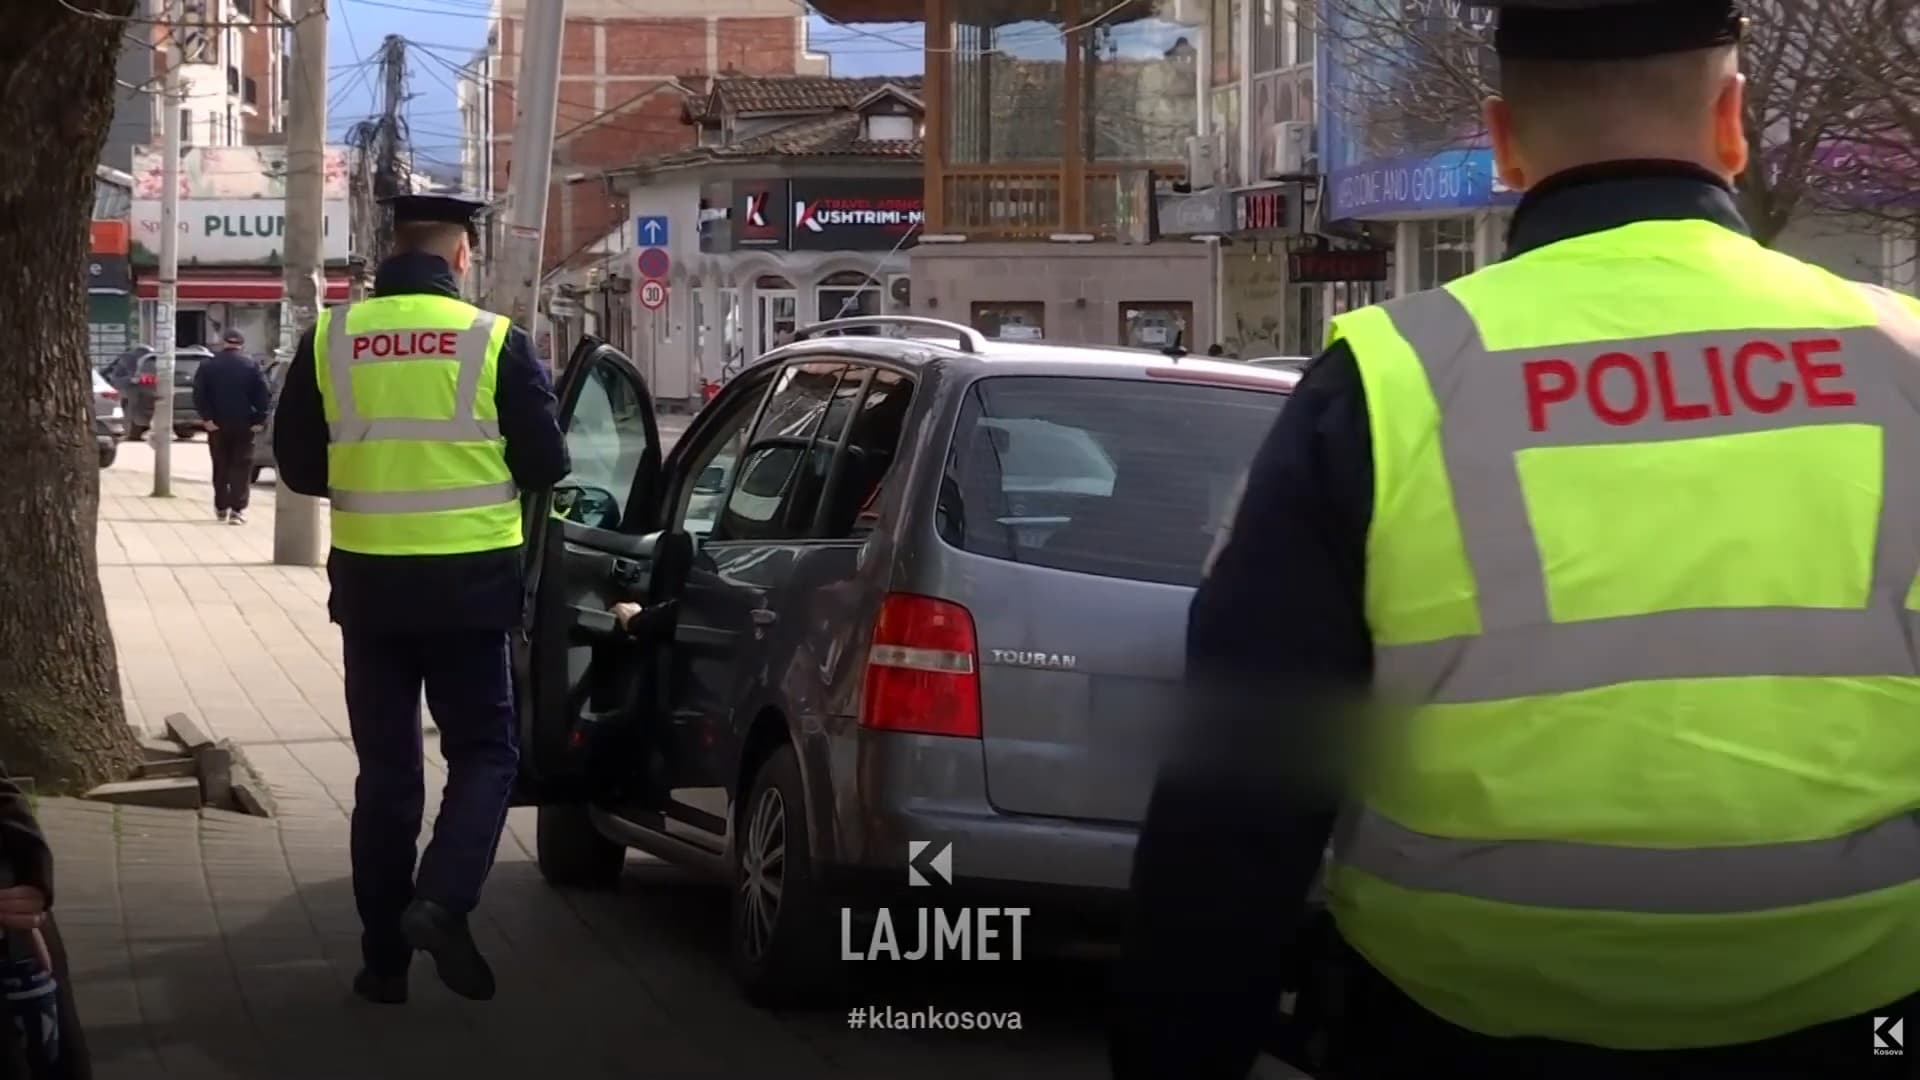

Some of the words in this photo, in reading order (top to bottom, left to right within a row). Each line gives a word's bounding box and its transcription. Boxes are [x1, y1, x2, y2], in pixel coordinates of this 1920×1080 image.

[1383, 169, 1409, 202] AND
[1412, 166, 1434, 202] GO
[796, 200, 925, 232] KUSHTRIMI-N
[877, 198, 923, 210] AGENC
[204, 215, 328, 237] PLLUI
[646, 287, 660, 302] 30
[353, 331, 458, 360] POLICE
[1522, 338, 1857, 432] POLICE
[992, 649, 1077, 667] TOURAN
